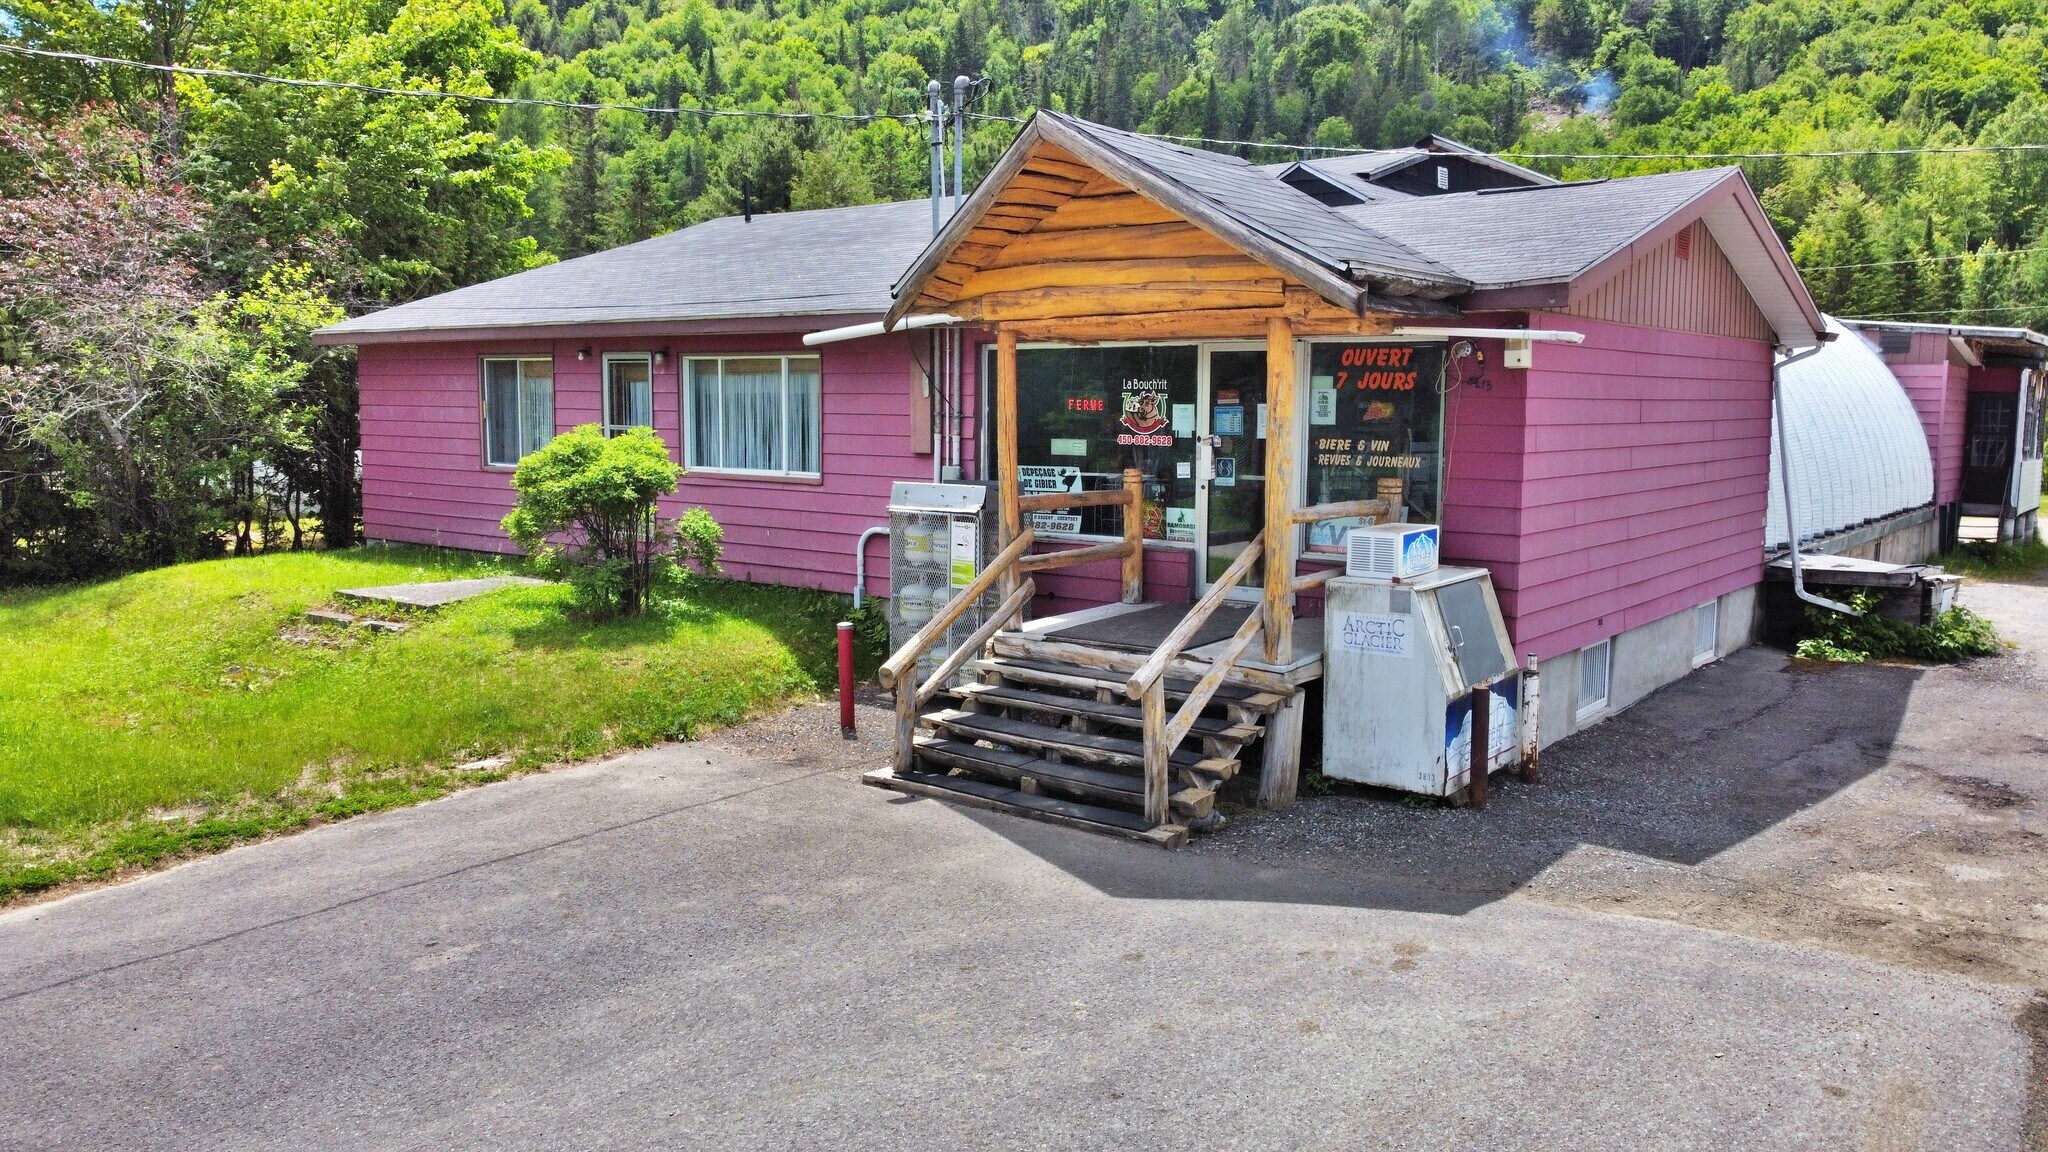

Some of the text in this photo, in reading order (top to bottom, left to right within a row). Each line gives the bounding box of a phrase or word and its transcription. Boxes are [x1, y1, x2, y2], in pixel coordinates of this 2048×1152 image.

[1341, 348, 1414, 367] OUVERT
[1122, 378, 1168, 390] La Bouch'rit
[1336, 371, 1418, 391] 7 JOURS
[1117, 434, 1173, 447] 450-882-9628
[1318, 438, 1390, 452] BIERE & VIN
[1317, 454, 1422, 469] REVUES & JOURNEAUX
[1023, 479, 1057, 489] DE GIBIER
[1342, 614, 1405, 637] ARCTIC
[1343, 631, 1404, 651] GLACIER
